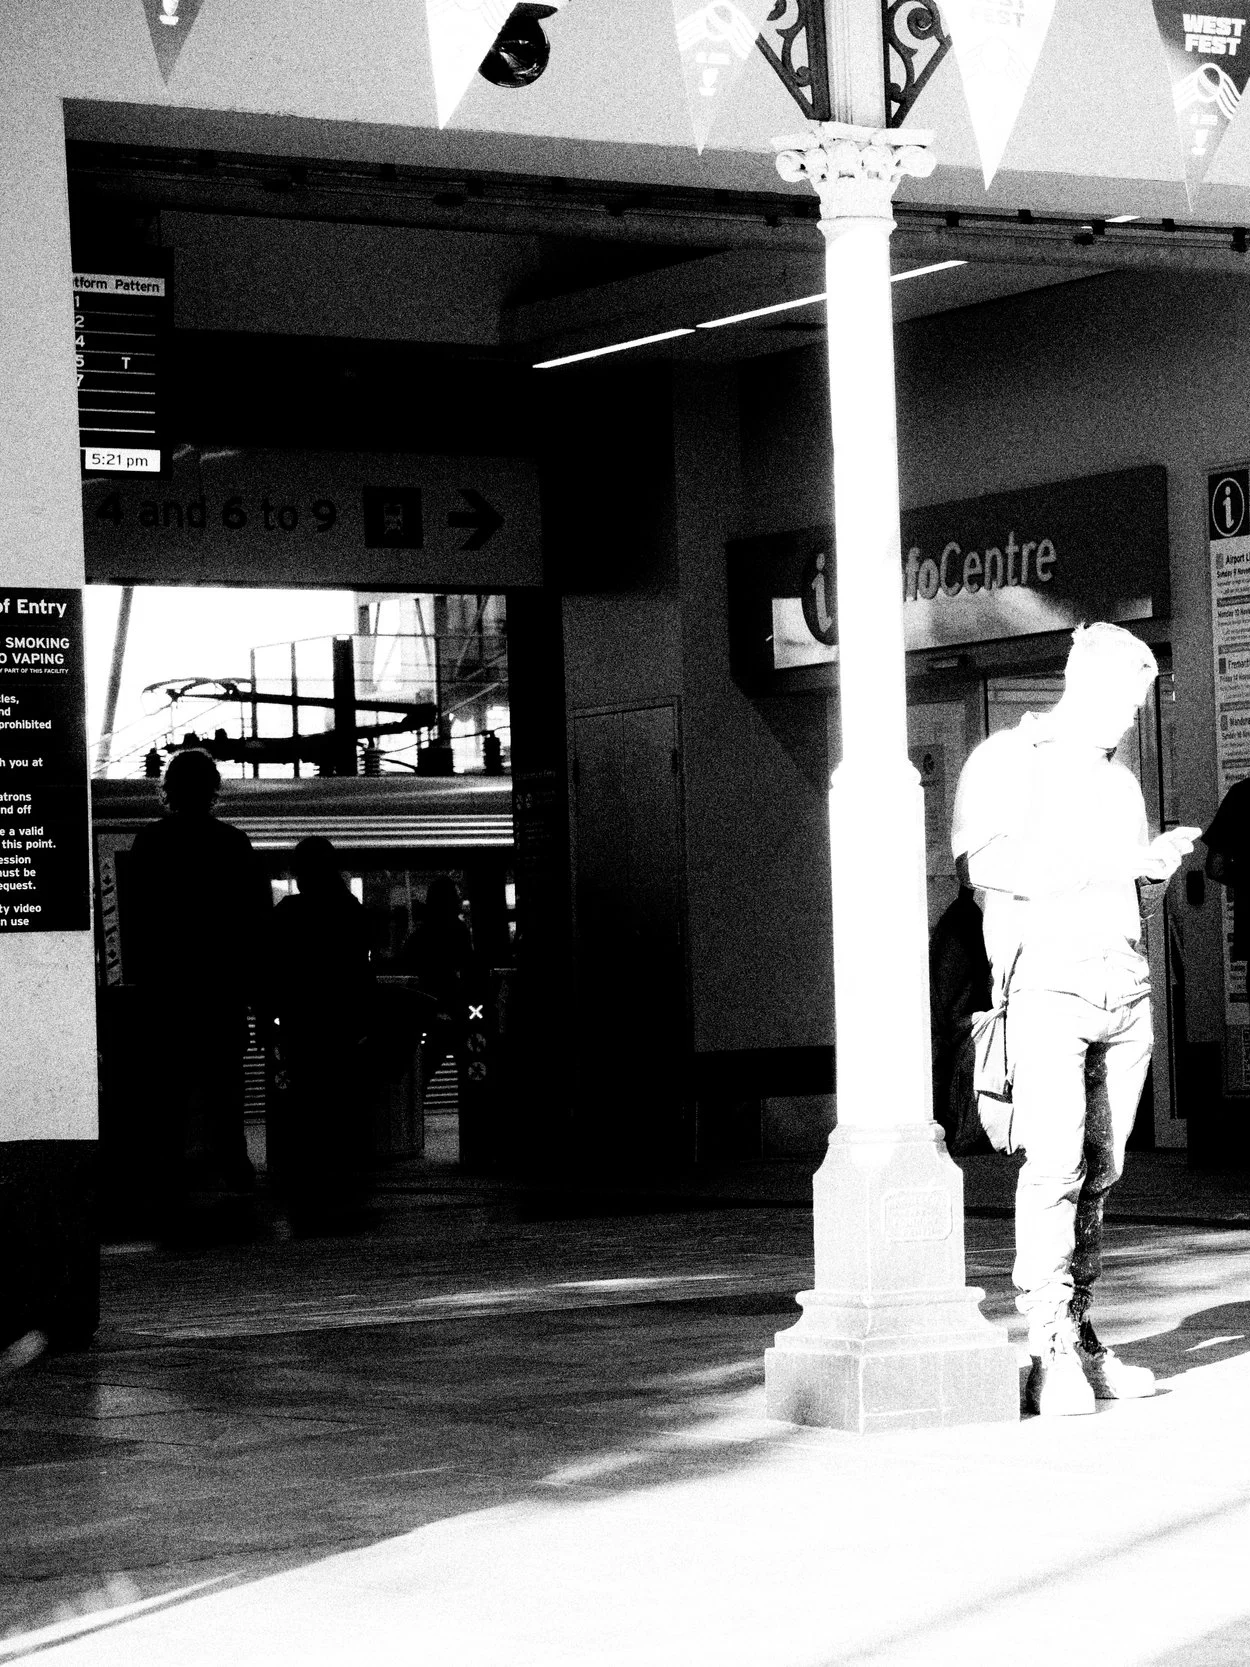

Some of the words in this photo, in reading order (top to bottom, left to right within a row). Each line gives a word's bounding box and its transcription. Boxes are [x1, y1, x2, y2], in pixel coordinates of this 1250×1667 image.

[1183, 13, 1246, 38] WEST
[1185, 33, 1241, 56] FEST
[115, 279, 160, 293] Pattern
[75, 315, 85, 328] 2
[75, 335, 86, 348] 4
[75, 354, 85, 367] 5
[121, 357, 131, 369] T
[91, 453, 121, 466] 5:21
[126, 457, 148, 468] pm
[96, 492, 122, 526] 4
[139, 496, 206, 528] and
[222, 497, 247, 529] 6
[261, 499, 300, 530] to
[312, 500, 337, 532] 9
[1226, 553, 1245, 565] Airport
[902, 531, 1057, 602] foCentre
[17, 599, 67, 618] Entry
[5, 637, 70, 649] SMOKING
[12, 653, 65, 665] VAPING
[0, 694, 20, 705] les,
[9, 759, 29, 769] you
[32, 757, 43, 767] at
[17, 804, 32, 814] off
[18, 826, 44, 836] valid
[1, 839, 23, 849] this
[26, 839, 56, 850] point.
[24, 867, 36, 877] be
[14, 903, 42, 913] video
[10, 918, 30, 926] use
